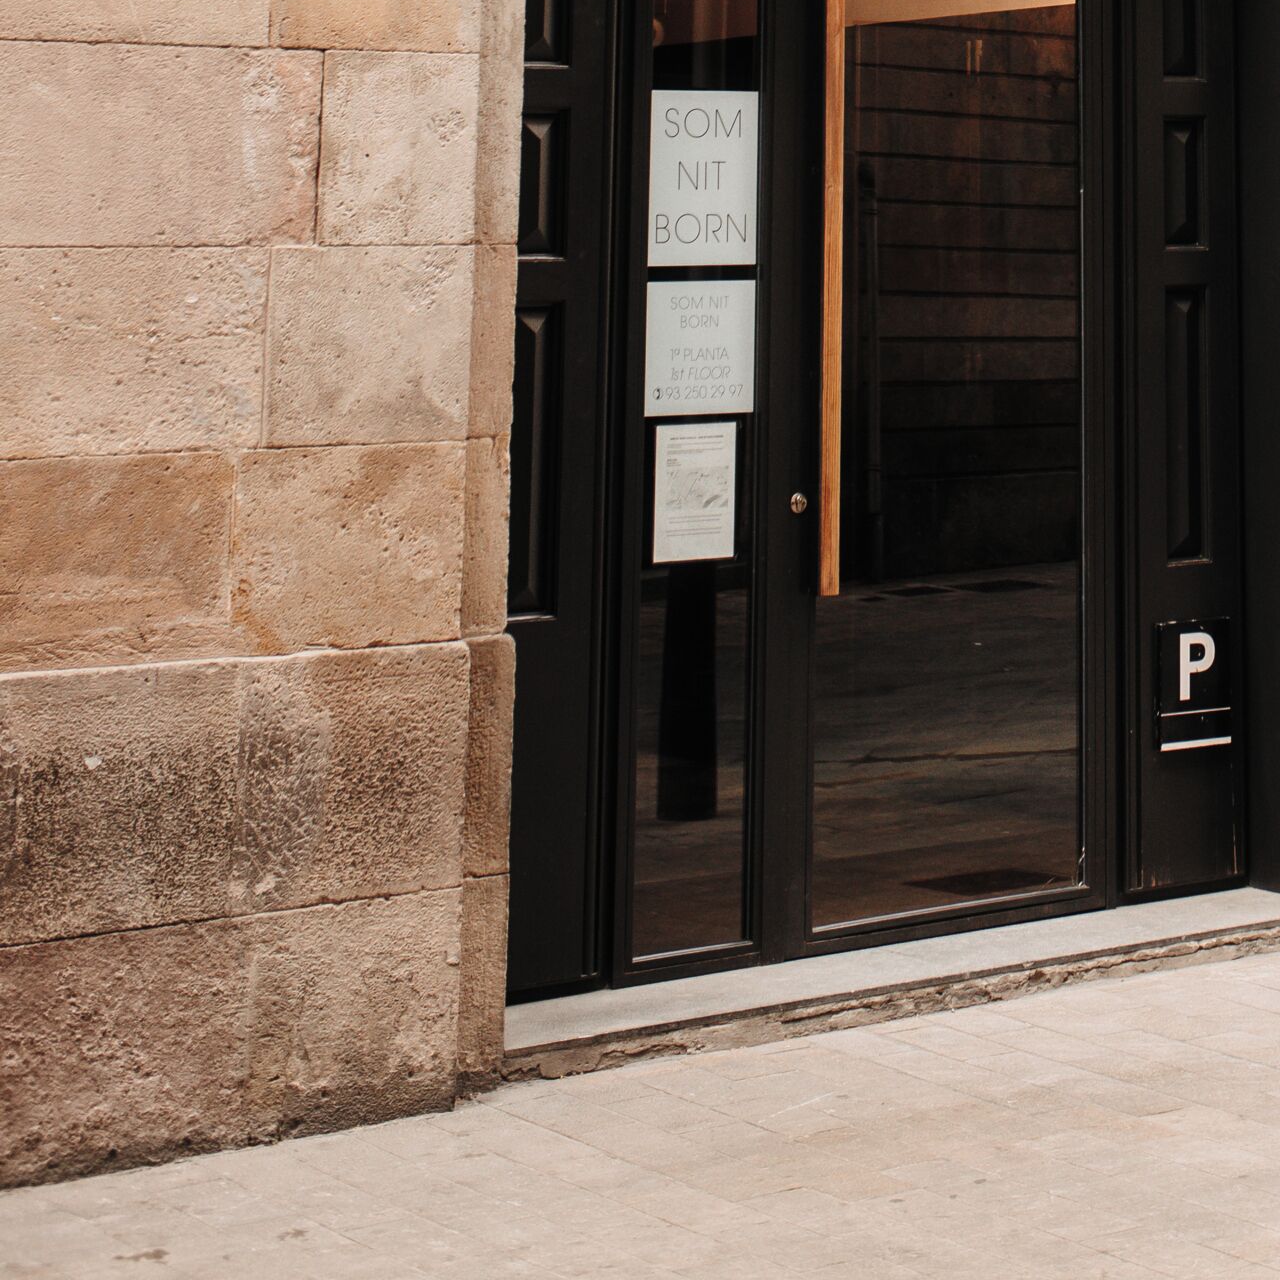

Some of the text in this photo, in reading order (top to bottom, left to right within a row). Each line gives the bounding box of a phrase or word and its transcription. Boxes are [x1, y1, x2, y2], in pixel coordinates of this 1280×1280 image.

[664, 107, 742, 139] SOM
[677, 160, 727, 190] NIT
[655, 213, 747, 245] BORN
[670, 295, 730, 311] SOM NIT
[679, 314, 720, 329] BORN
[683, 345, 730, 362] PLANTA
[671, 365, 731, 381] 1st FLOOR
[665, 383, 744, 401] 93 250 29 97
[1179, 631, 1216, 702] P
